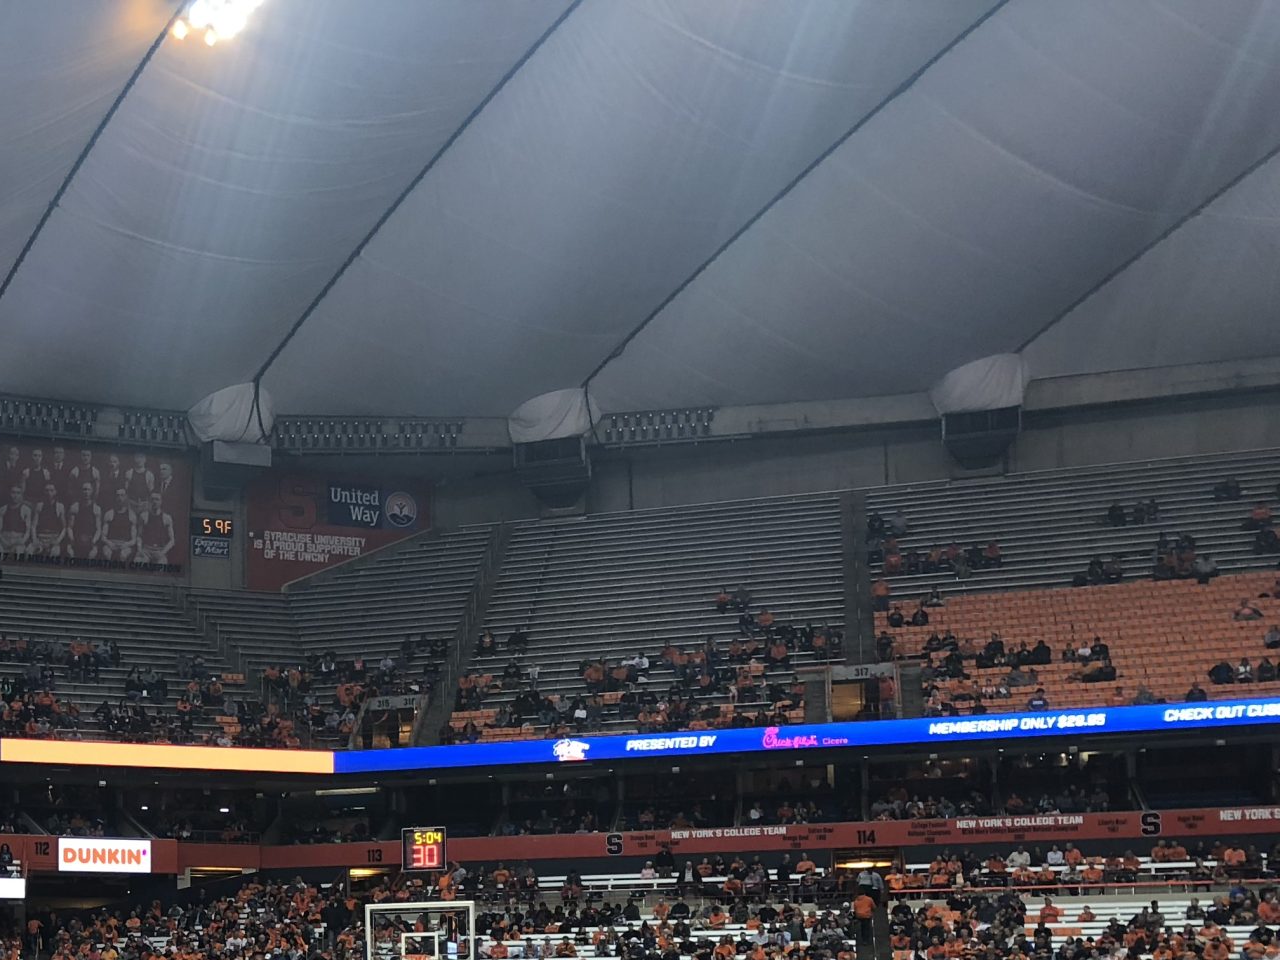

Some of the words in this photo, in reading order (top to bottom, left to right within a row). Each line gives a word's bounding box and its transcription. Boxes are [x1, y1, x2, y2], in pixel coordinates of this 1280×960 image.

[330, 487, 380, 506] United
[350, 505, 380, 526] Way
[264, 531, 312, 543] SYRACUSE
[314, 534, 366, 547] UNIVERSITY
[254, 539, 263, 549] IS
[265, 540, 271, 549] A
[273, 540, 305, 551] PROUD
[307, 543, 361, 556] SUPPORTER
[264, 550, 276, 559] OF
[278, 551, 296, 561] THE
[854, 667, 869, 677] 317
[1164, 707, 1213, 722] CHECK
[1215, 706, 1245, 719] OUT
[929, 717, 1018, 735] MEMBERSHIP
[1020, 715, 1057, 730] ONLY
[626, 736, 697, 751] PRESENTED
[699, 735, 718, 748] BY
[822, 736, 849, 746] Cicero
[956, 819, 978, 829] NEW
[979, 818, 1012, 828] YORK'S
[1014, 816, 1055, 827] COLLEGE
[1057, 815, 1083, 825] TEAM
[1220, 809, 1242, 821] NEW
[1141, 812, 1161, 837] S
[414, 832, 441, 845] 5:04
[671, 830, 690, 840] NEW
[691, 829, 722, 839] YORK'S
[723, 827, 761, 838] COLLEGE
[762, 826, 787, 836] TEAM
[857, 830, 876, 844] 114
[34, 842, 49, 856] 112
[606, 833, 623, 855] S
[63, 847, 147, 865] DUNKIN'
[367, 849, 382, 863] 113
[412, 845, 438, 866] 30
